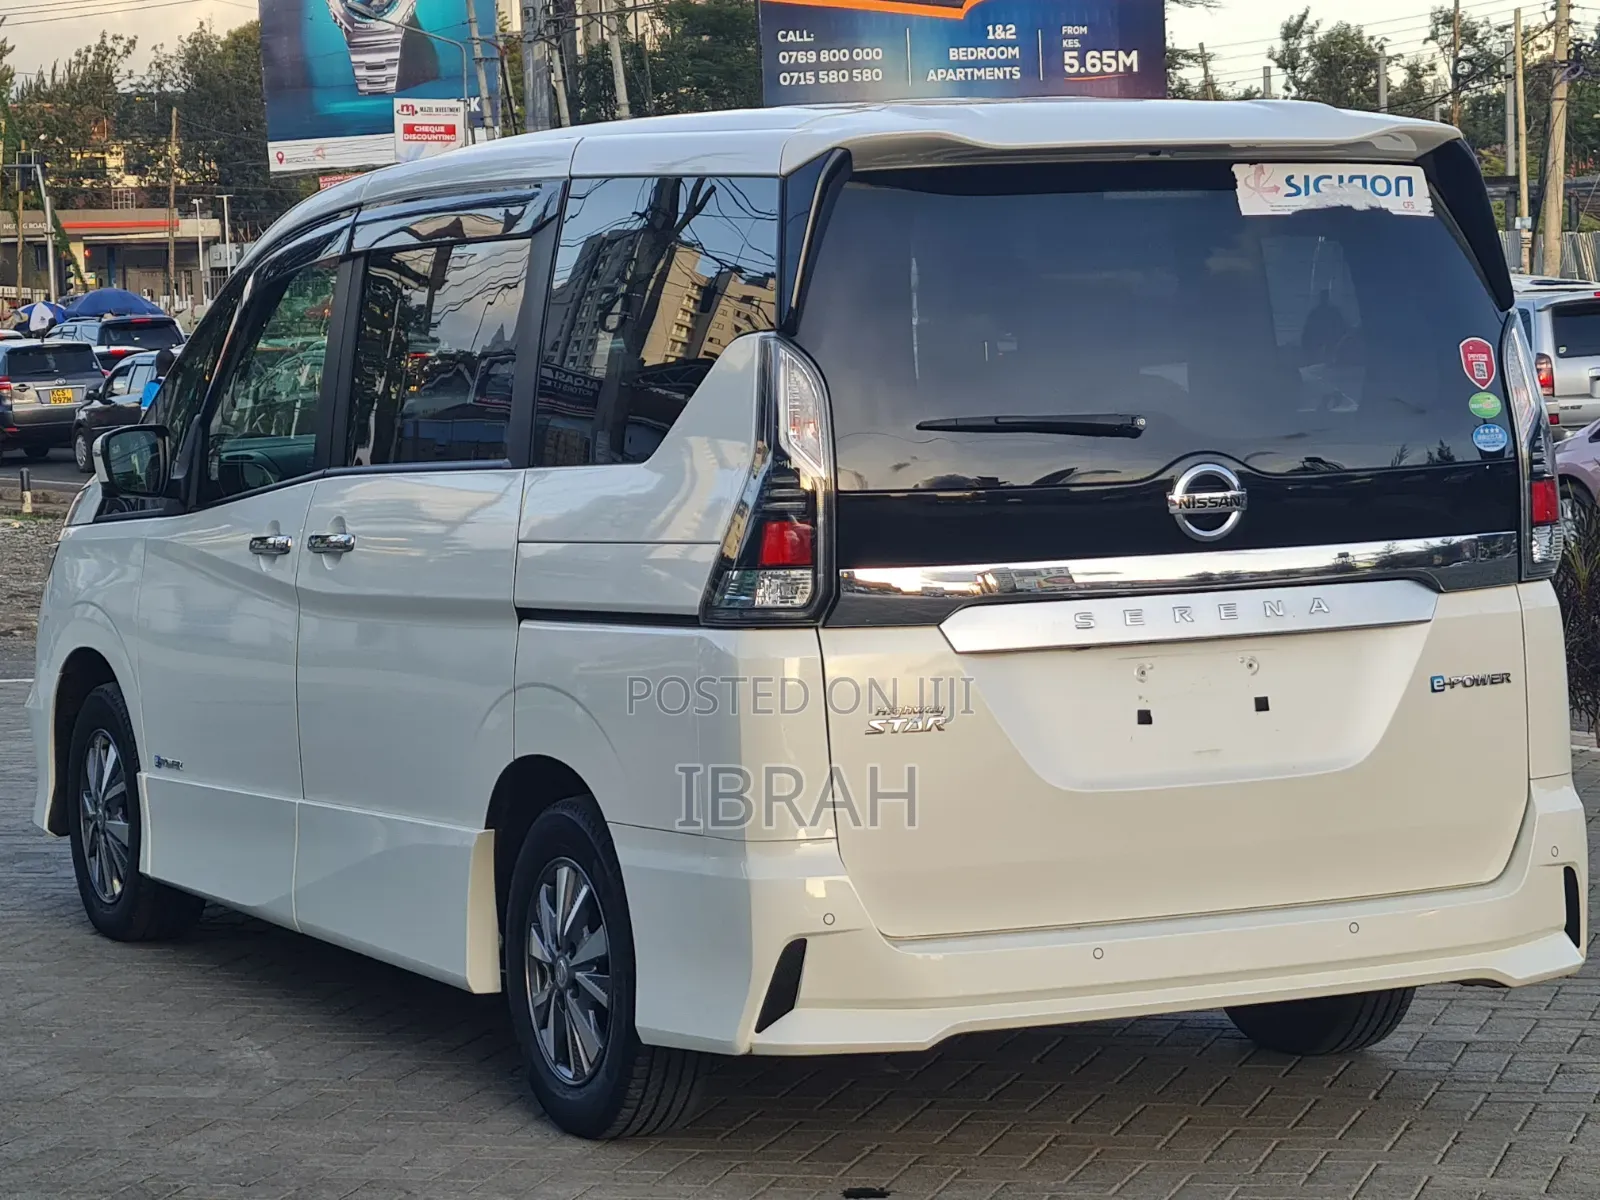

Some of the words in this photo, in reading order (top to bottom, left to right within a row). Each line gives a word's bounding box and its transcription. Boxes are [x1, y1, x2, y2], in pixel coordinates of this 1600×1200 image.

[777, 29, 815, 42] CALL:
[986, 24, 1017, 40] 1&2
[1061, 25, 1088, 35] FROM
[1062, 38, 1082, 48] KES.
[778, 50, 817, 64] 0769
[819, 48, 850, 62] 800
[852, 47, 883, 61] 000
[949, 46, 1020, 61] BEDROOM
[1063, 49, 1139, 74] 5.65M
[779, 71, 816, 86] 0715
[818, 69, 849, 84] 580
[852, 68, 883, 82] 580
[926, 66, 1021, 82] APARTMENTS
[403, 133, 456, 141] DISCOUNTING
[413, 125, 446, 133] CHEQUE
[1177, 494, 1242, 511] NISSAN
[1074, 597, 1330, 629] SERENA
[1430, 672, 1512, 693] e-POWER
[875, 705, 946, 719] Highway
[864, 716, 946, 736] STAR
